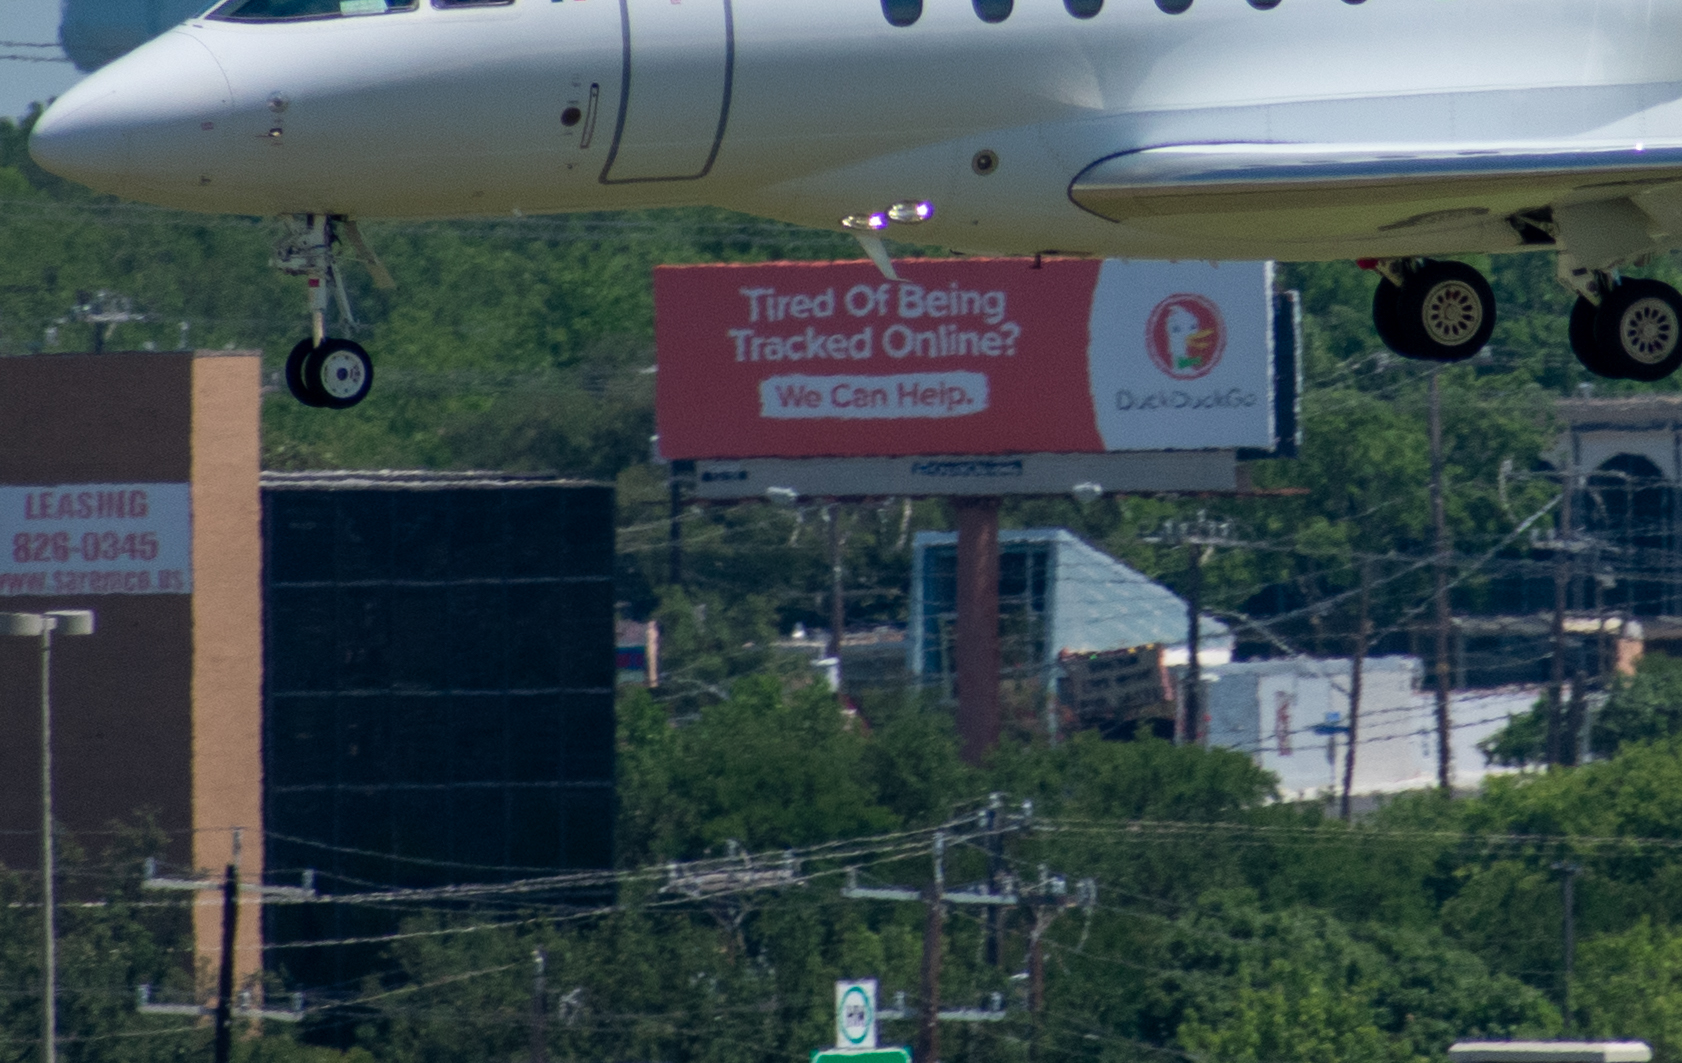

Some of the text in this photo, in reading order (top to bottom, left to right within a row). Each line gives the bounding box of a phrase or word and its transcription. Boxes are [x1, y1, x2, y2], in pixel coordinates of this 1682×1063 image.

[740, 282, 1006, 324] Tired Of Being
[728, 322, 1020, 362] Tracked Online?
[775, 382, 974, 412] We Can Help.
[25, 490, 148, 520] LEASING
[13, 531, 159, 563] 826-0345
